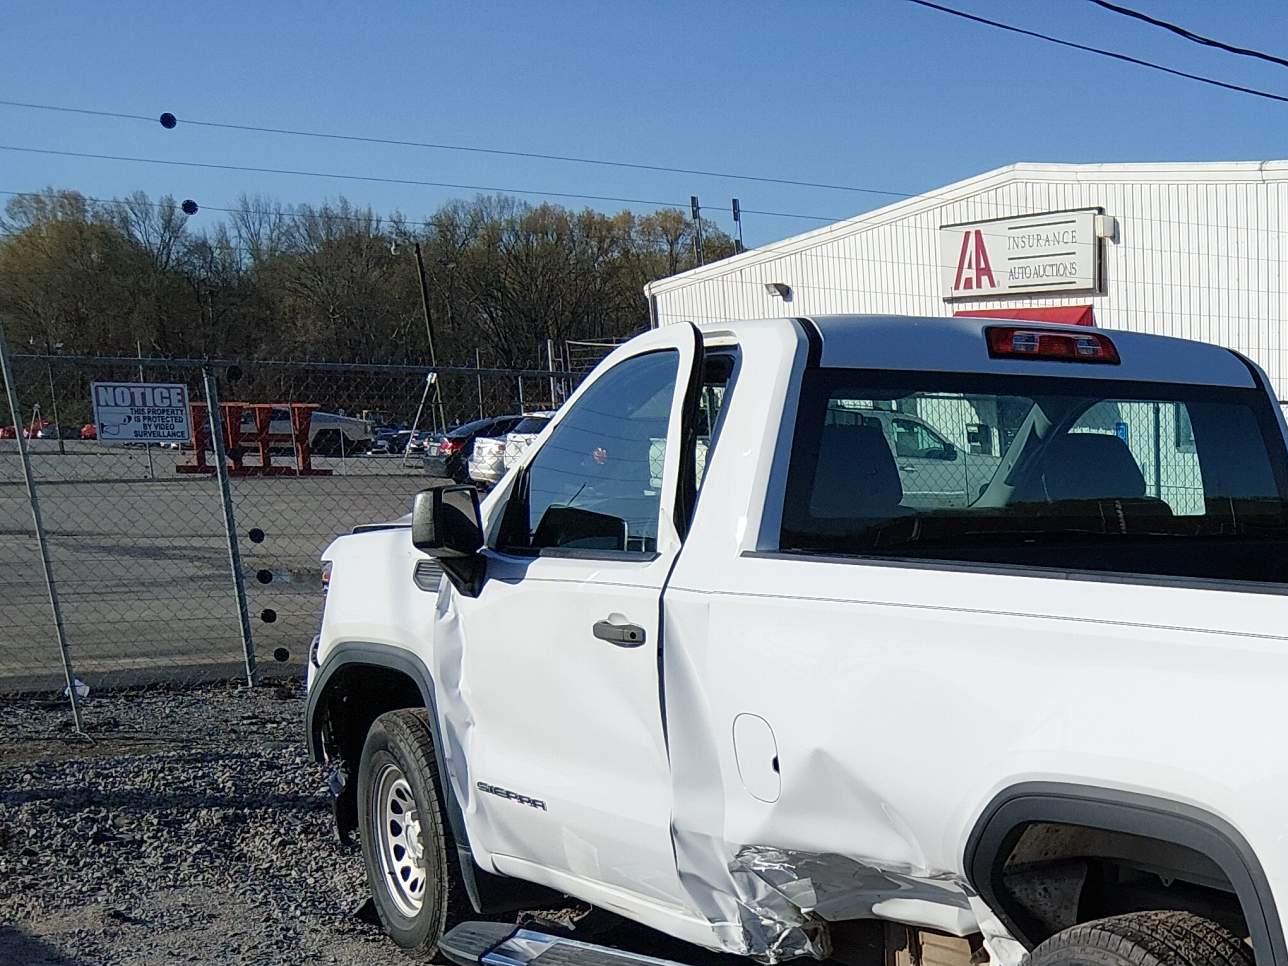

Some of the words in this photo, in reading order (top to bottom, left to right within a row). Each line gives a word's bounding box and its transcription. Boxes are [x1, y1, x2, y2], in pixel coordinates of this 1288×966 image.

[1007, 230, 1078, 250] INSURANCE
[1008, 265, 1032, 281] AUTO
[1032, 262, 1078, 279] AUCTIONS
[98, 387, 184, 406] NOTICE
[147, 408, 184, 416] PROPERTY
[134, 430, 185, 438] SURVEILLANCE
[476, 781, 548, 812] SIERRA
